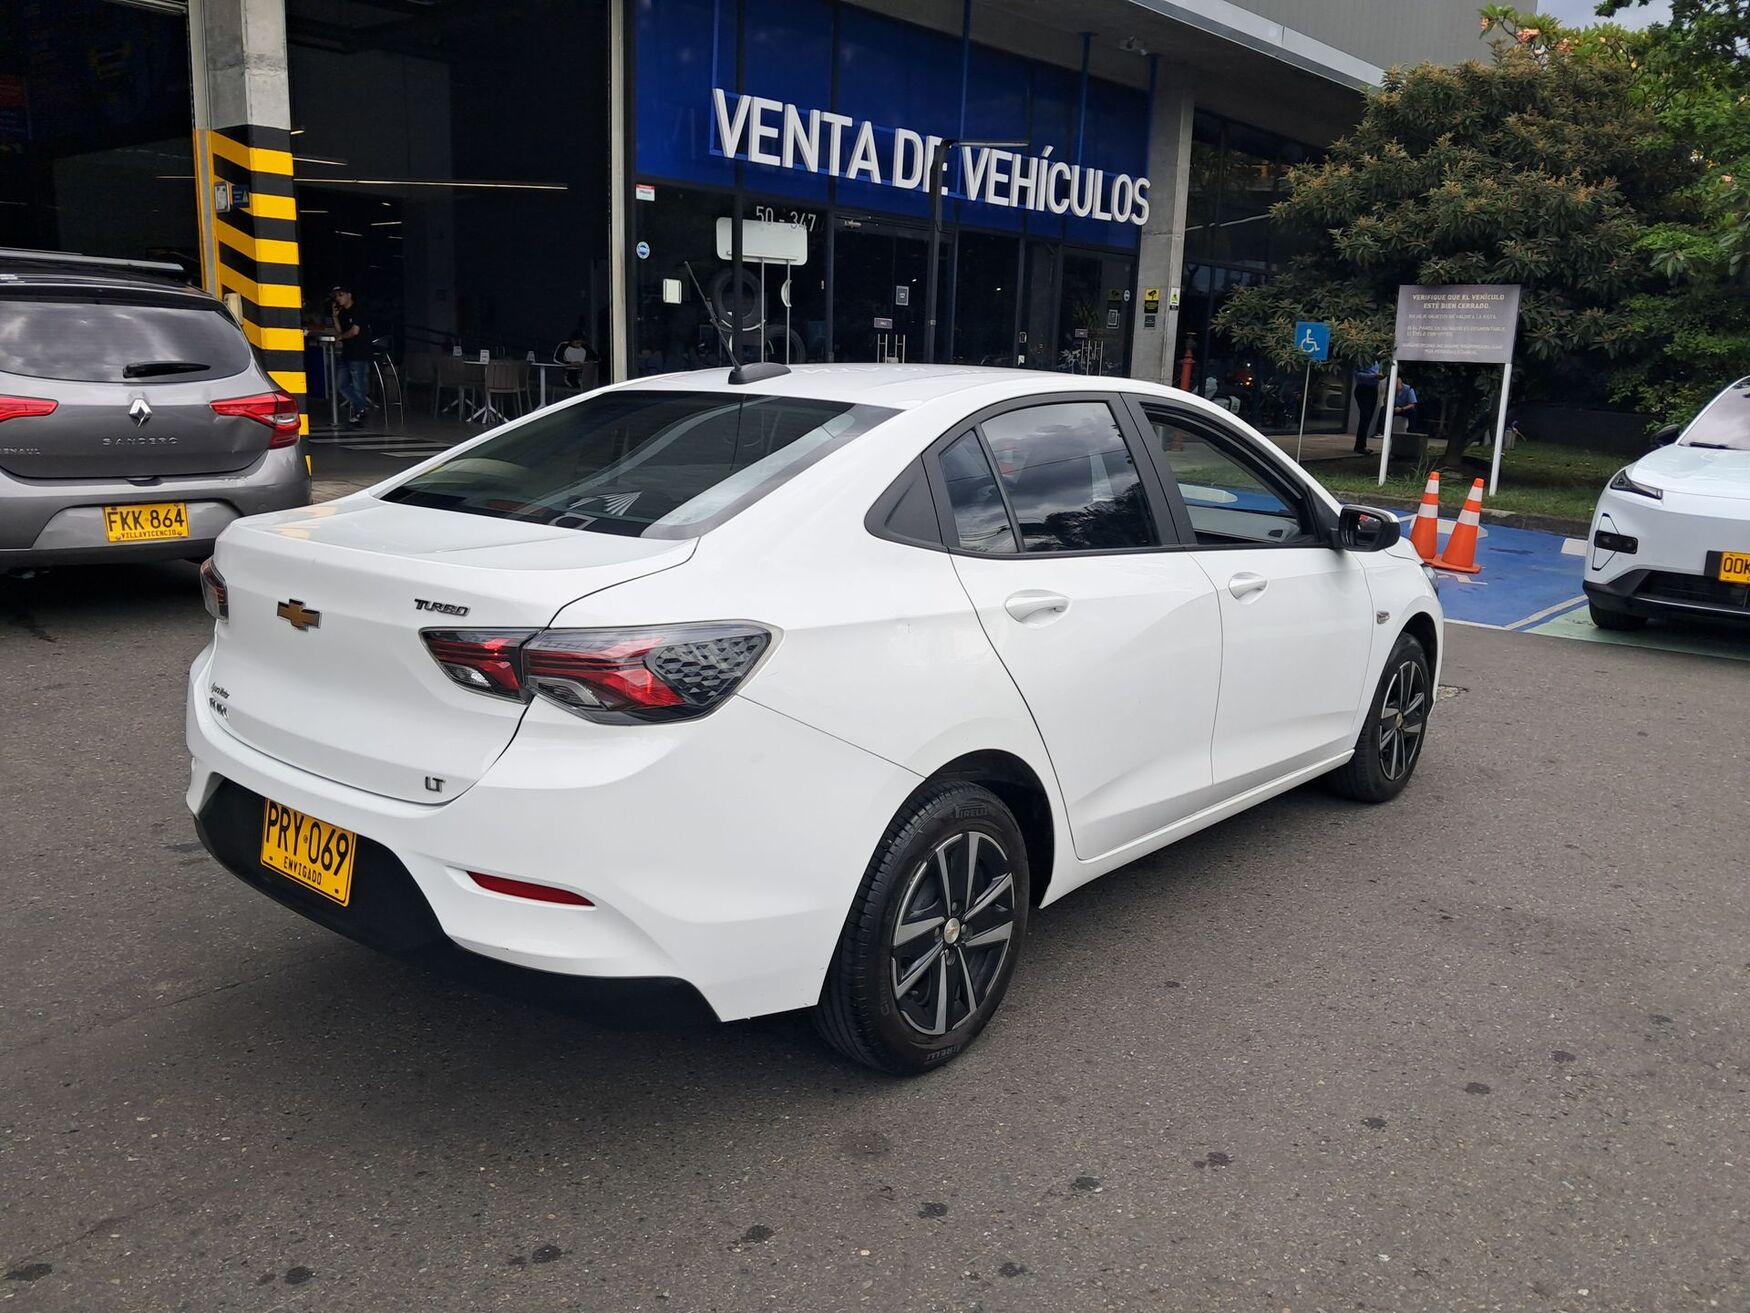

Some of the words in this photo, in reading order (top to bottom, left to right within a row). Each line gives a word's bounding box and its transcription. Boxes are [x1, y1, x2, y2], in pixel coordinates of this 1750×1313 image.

[712, 87, 882, 185] VENTA
[961, 144, 1151, 226] VEHÍCULOS
[107, 510, 144, 532] FKK
[149, 508, 185, 529] 864
[414, 598, 470, 617] TURBO
[424, 775, 446, 793] LT
[266, 803, 304, 857] PRY
[307, 822, 349, 877] 069
[283, 855, 323, 886] ENVIGADO
